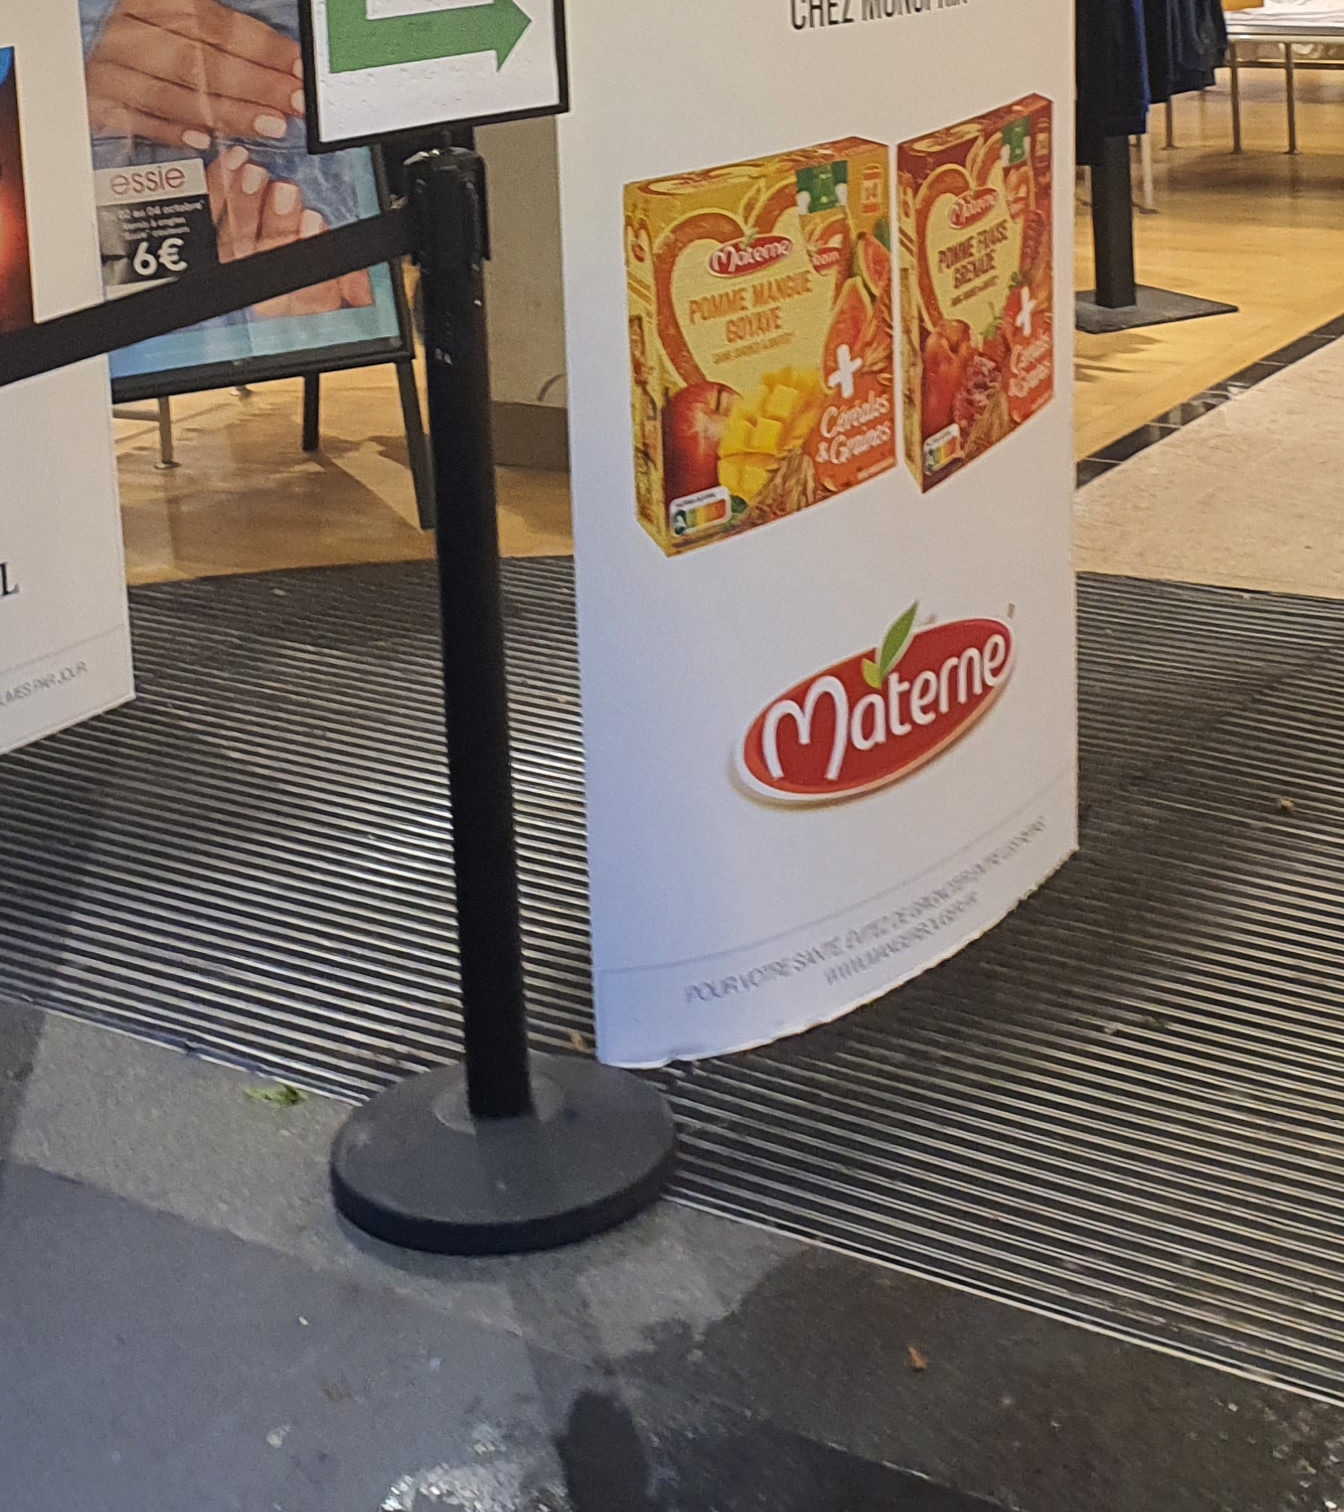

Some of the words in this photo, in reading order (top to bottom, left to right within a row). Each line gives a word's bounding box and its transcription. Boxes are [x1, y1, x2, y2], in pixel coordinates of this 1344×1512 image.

[110, 164, 186, 197] essie
[133, 237, 189, 276] 6€
[761, 634, 1008, 781] Materne
